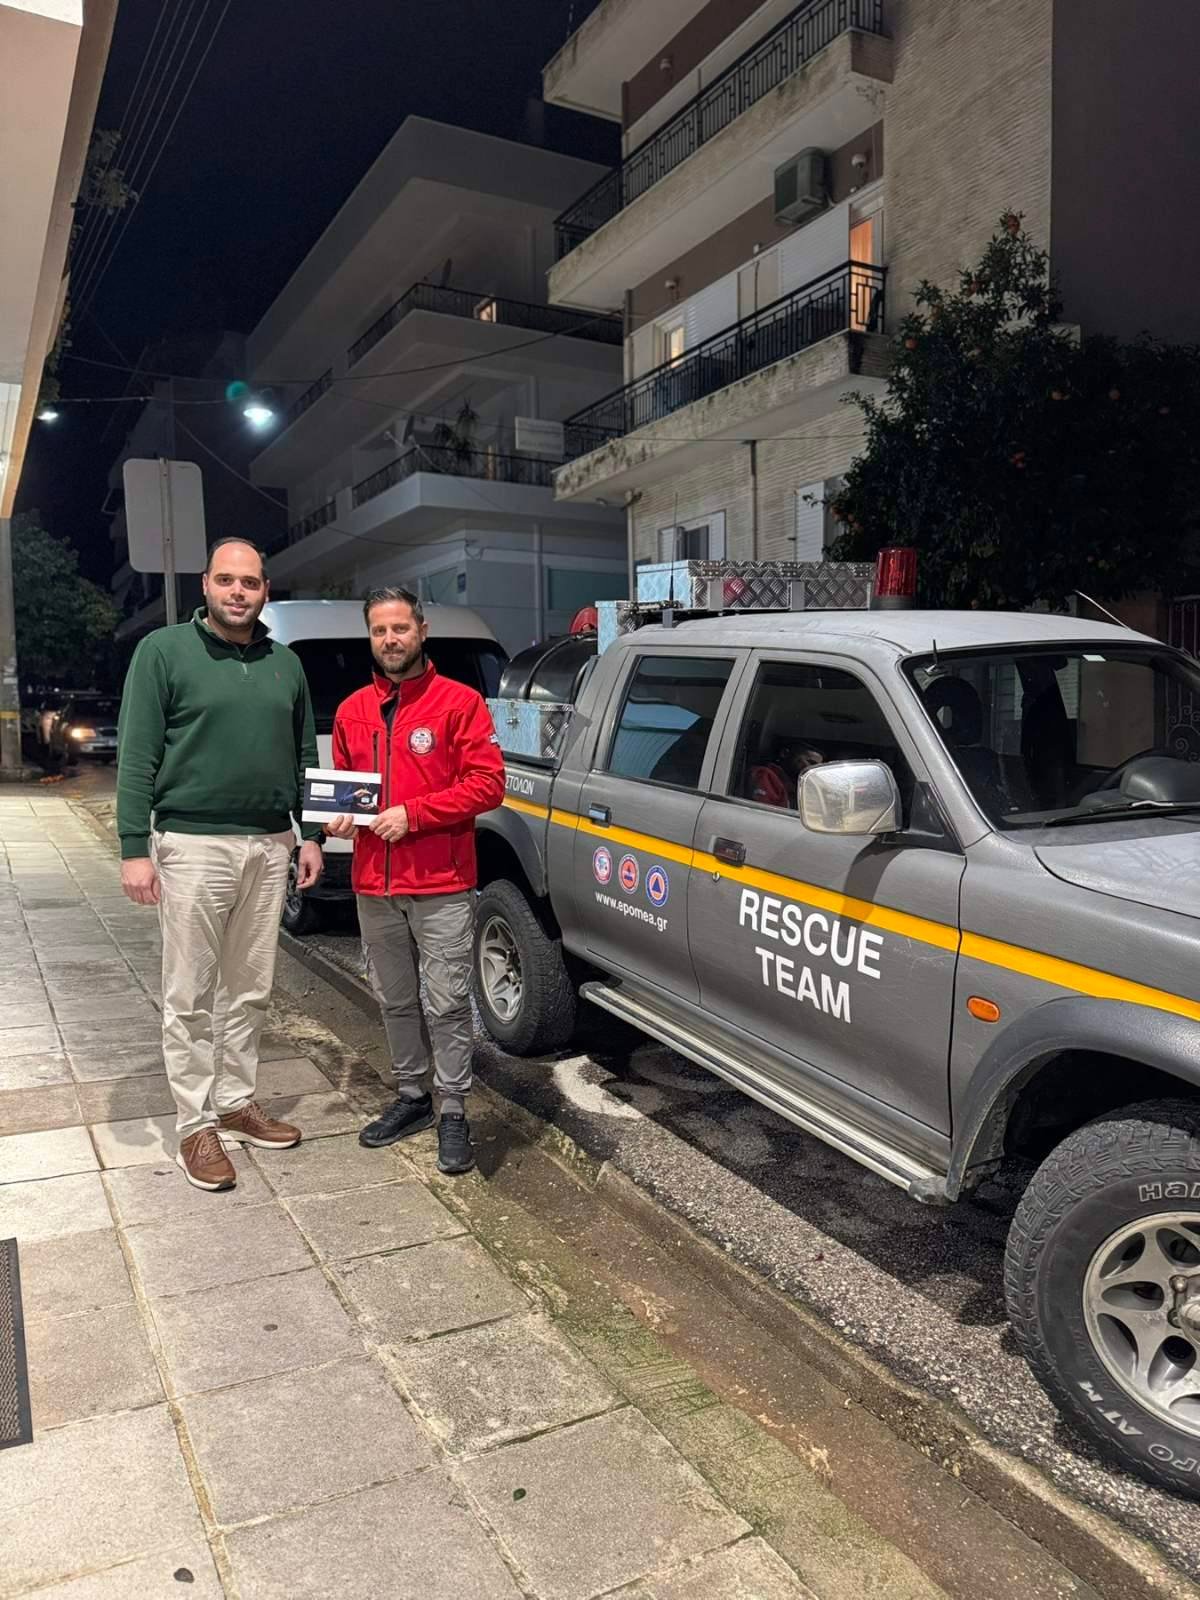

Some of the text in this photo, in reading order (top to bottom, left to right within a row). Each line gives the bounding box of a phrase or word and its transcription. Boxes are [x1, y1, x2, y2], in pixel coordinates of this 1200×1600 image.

[595, 891, 668, 932] www.epomea.gr
[739, 888, 884, 980] RESCUE
[755, 946, 851, 1024] TEAM
